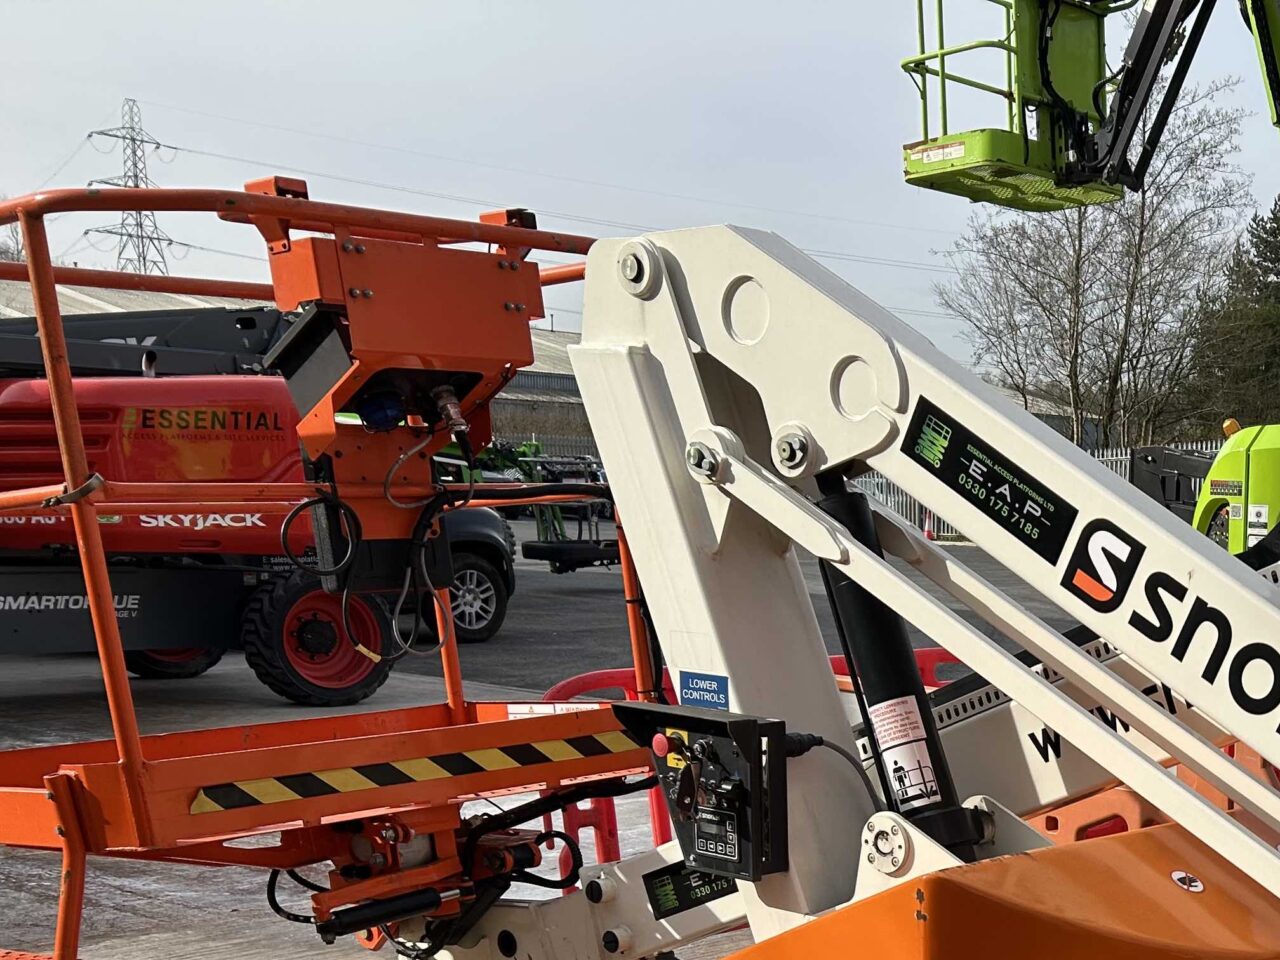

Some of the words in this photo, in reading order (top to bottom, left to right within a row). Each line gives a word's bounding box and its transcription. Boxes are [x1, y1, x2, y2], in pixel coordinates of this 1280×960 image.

[142, 408, 284, 431] ESSENTIAL
[966, 443, 993, 468] ESSENTIAL
[994, 464, 1013, 482] ACCESS
[958, 473, 987, 500] 0330
[989, 495, 1009, 517] 175
[1012, 512, 1040, 540] 7185
[140, 512, 267, 530] SKYJACK
[688, 678, 718, 691] LOWER
[682, 689, 726, 704] CONTROLS
